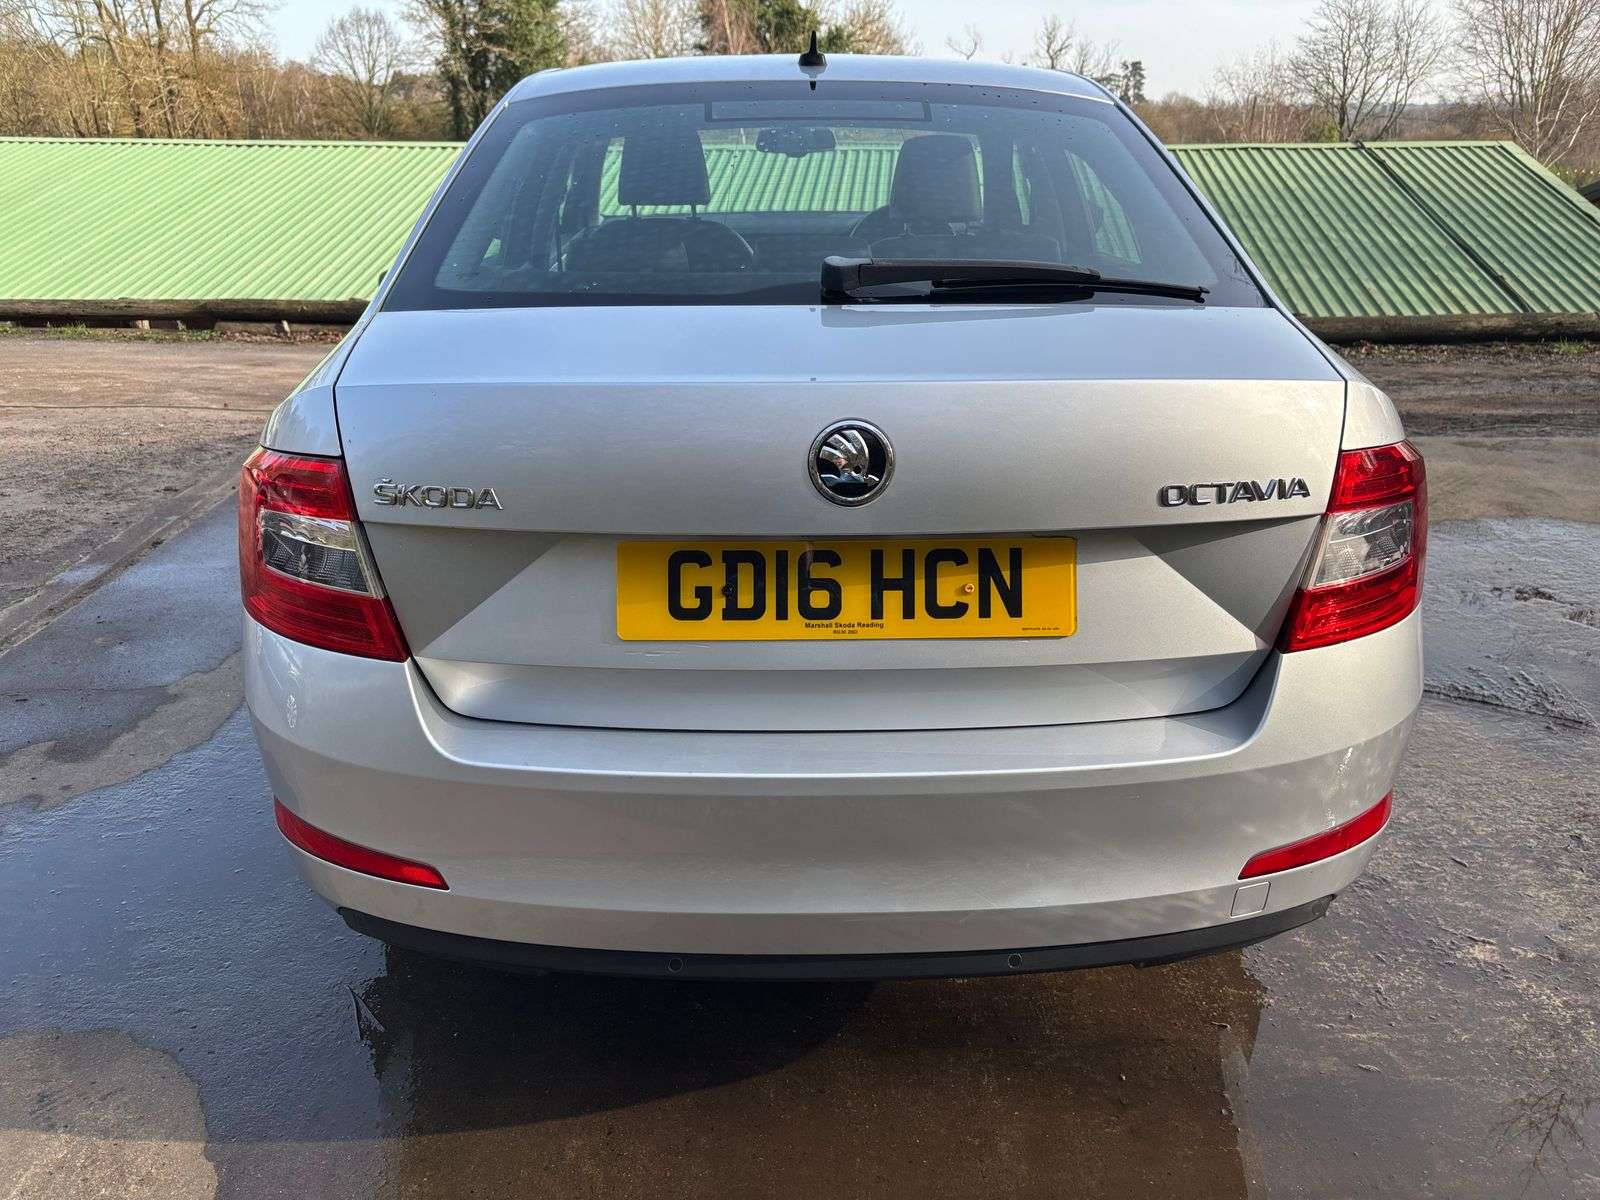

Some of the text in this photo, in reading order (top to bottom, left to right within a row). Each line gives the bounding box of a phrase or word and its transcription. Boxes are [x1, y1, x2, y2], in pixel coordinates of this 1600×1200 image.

[373, 478, 503, 510] ŠKODA
[1157, 477, 1311, 507] OCTAVIA
[668, 548, 1023, 620] GD16 HCN
